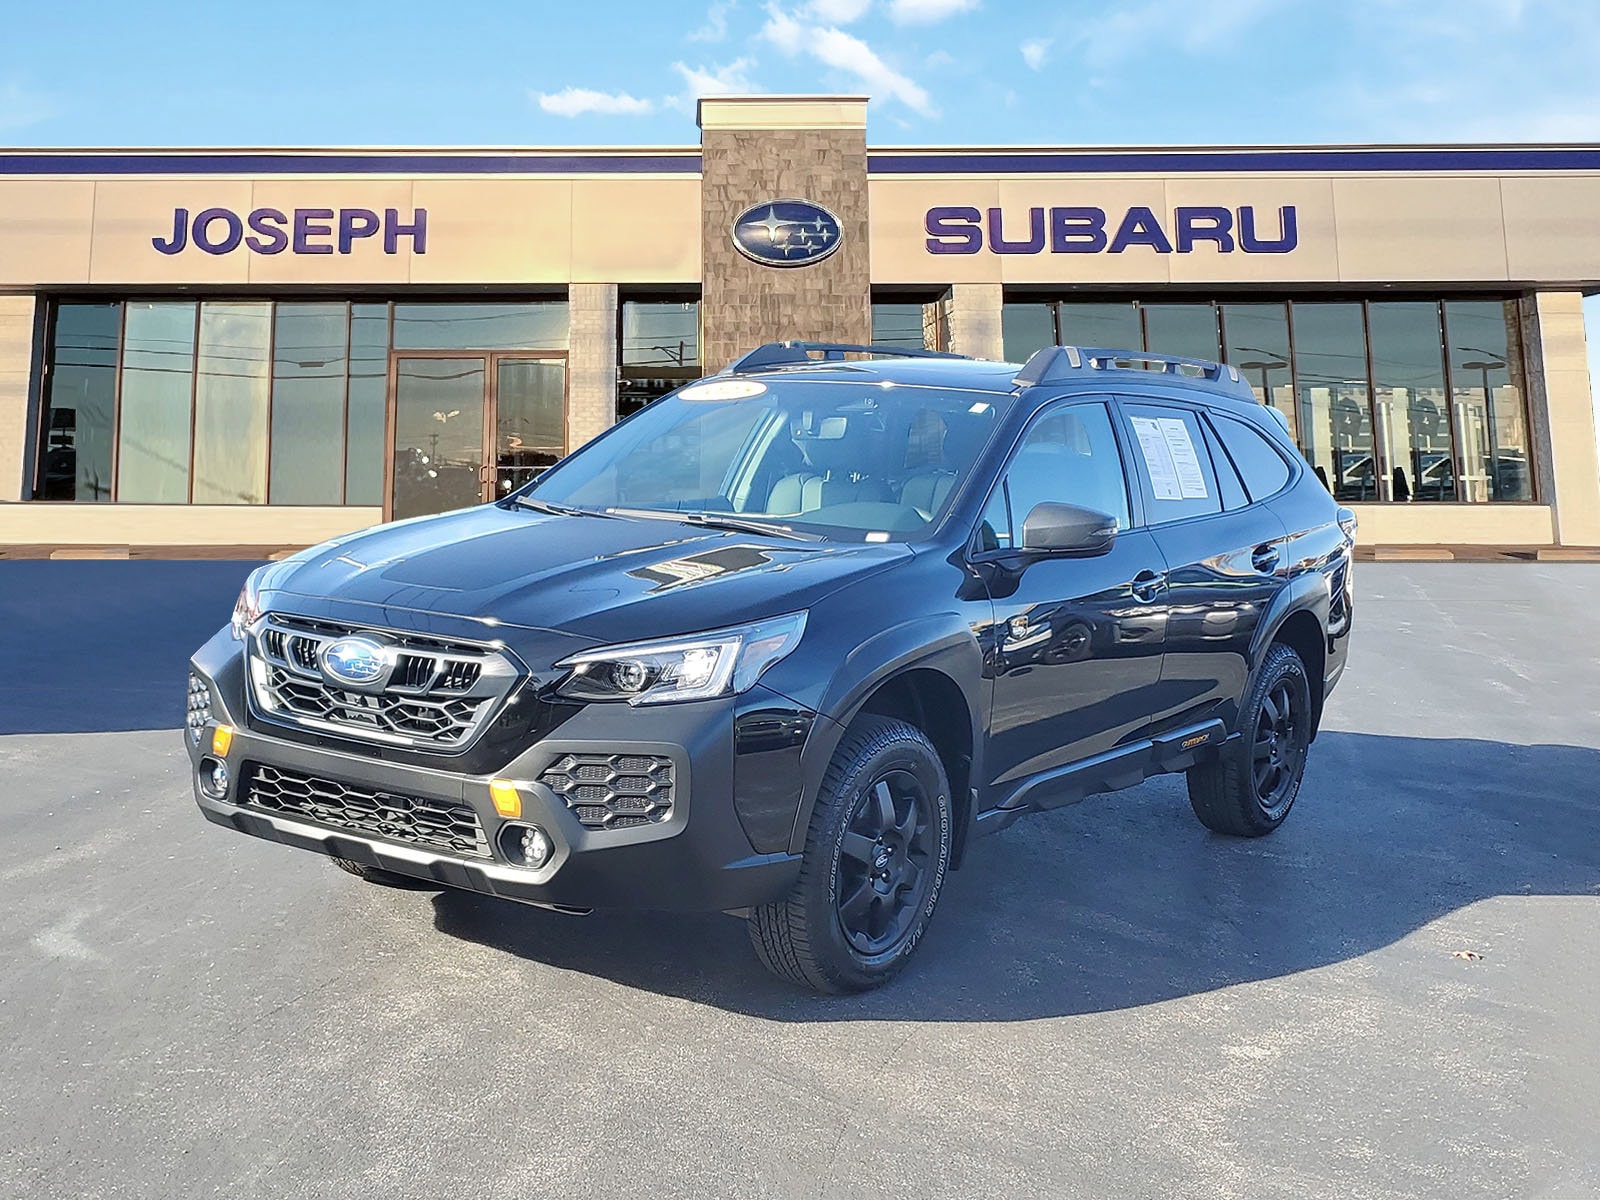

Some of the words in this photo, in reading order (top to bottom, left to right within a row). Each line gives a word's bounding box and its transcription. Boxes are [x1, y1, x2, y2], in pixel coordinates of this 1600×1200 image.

[152, 207, 427, 255] JOSEPH
[925, 206, 1298, 255] SUBARU
[925, 794, 948, 917] GEOLANDAR
